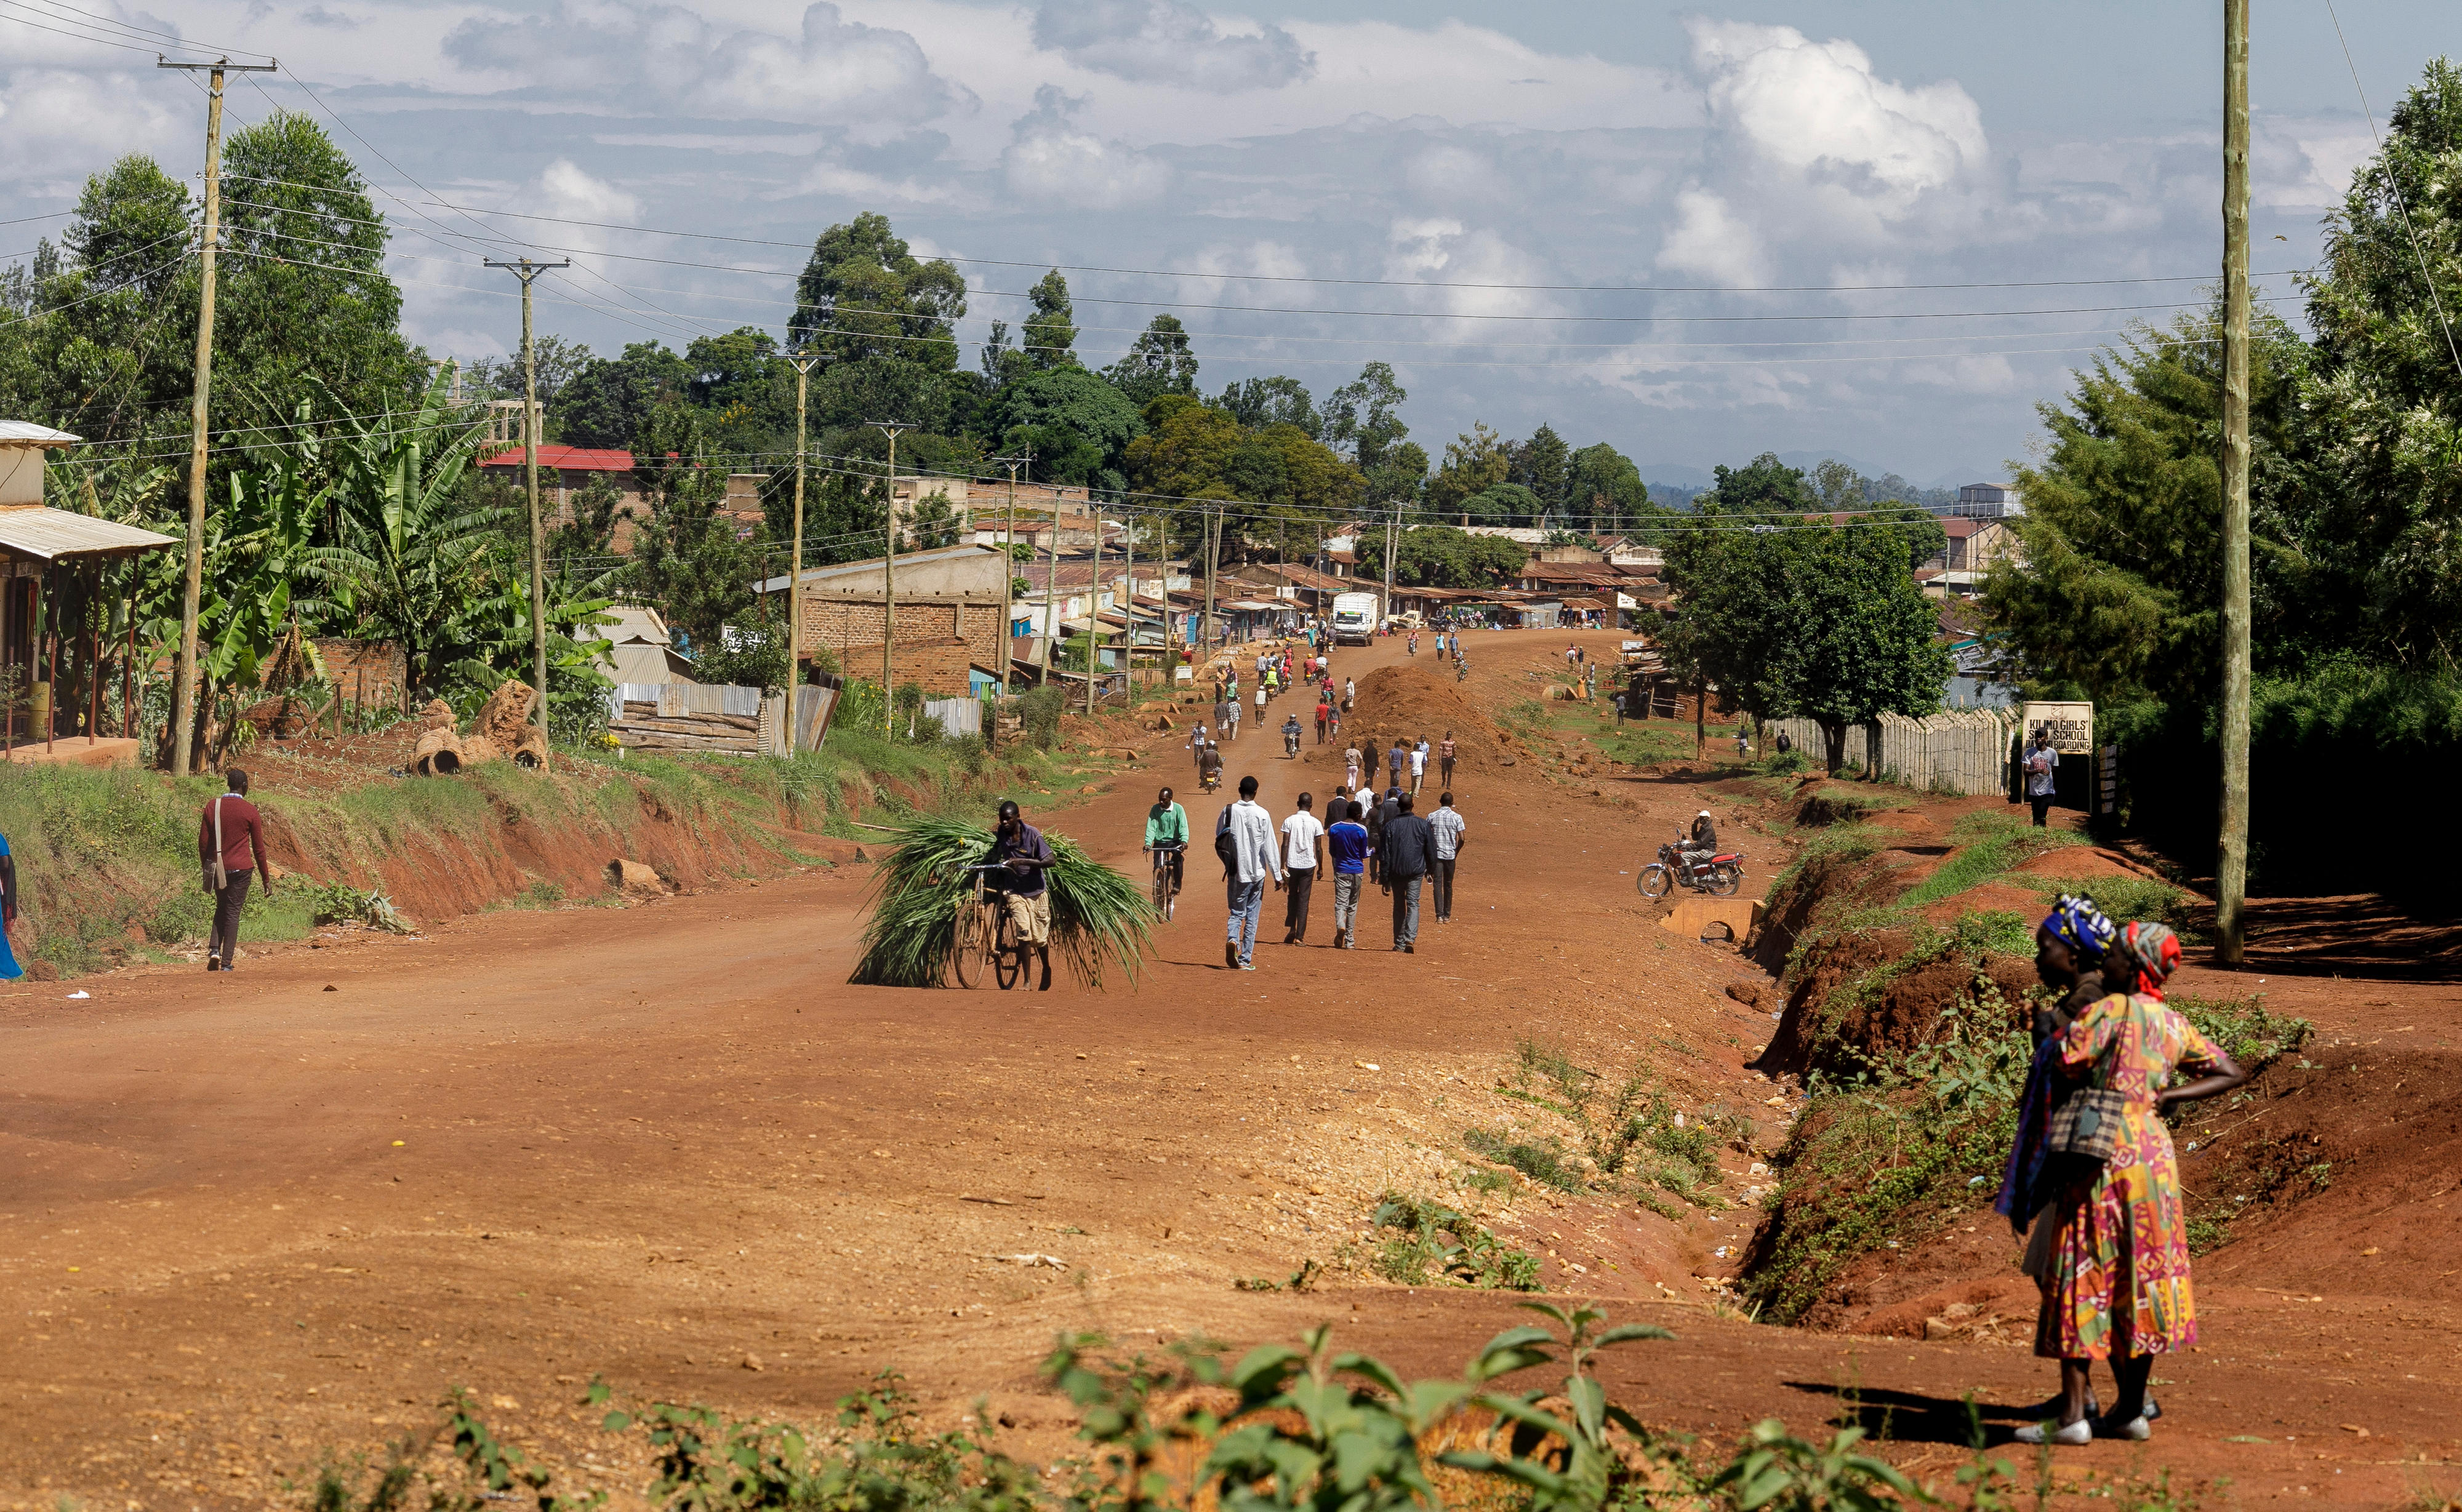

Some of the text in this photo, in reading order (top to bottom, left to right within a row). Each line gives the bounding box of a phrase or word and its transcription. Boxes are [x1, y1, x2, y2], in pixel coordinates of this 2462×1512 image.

[2029, 719, 2088, 730] KILIMO GIRLS'
[2053, 730, 2088, 740] SCHOOL
[2054, 740, 2090, 750] BOARDING
